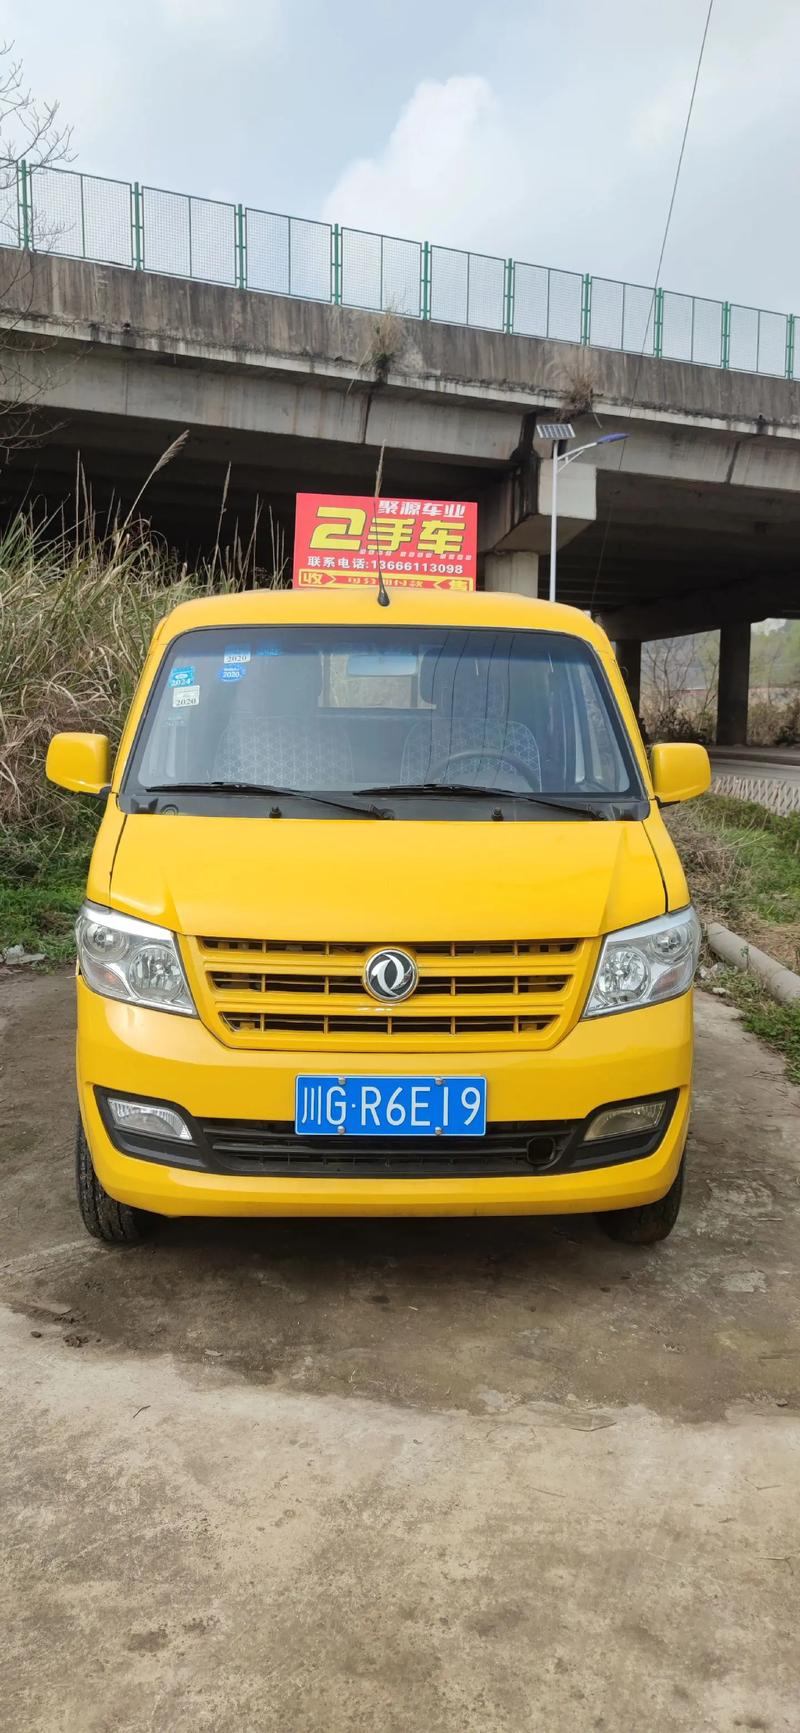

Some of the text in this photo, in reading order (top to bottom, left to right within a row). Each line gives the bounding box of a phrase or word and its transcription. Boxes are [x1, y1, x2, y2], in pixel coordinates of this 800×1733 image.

[378, 500, 466, 519] 聚源车业
[309, 506, 467, 555] 2手车
[303, 572, 324, 585] 收
[171, 678, 191, 686] 2024
[176, 698, 197, 706] 2020
